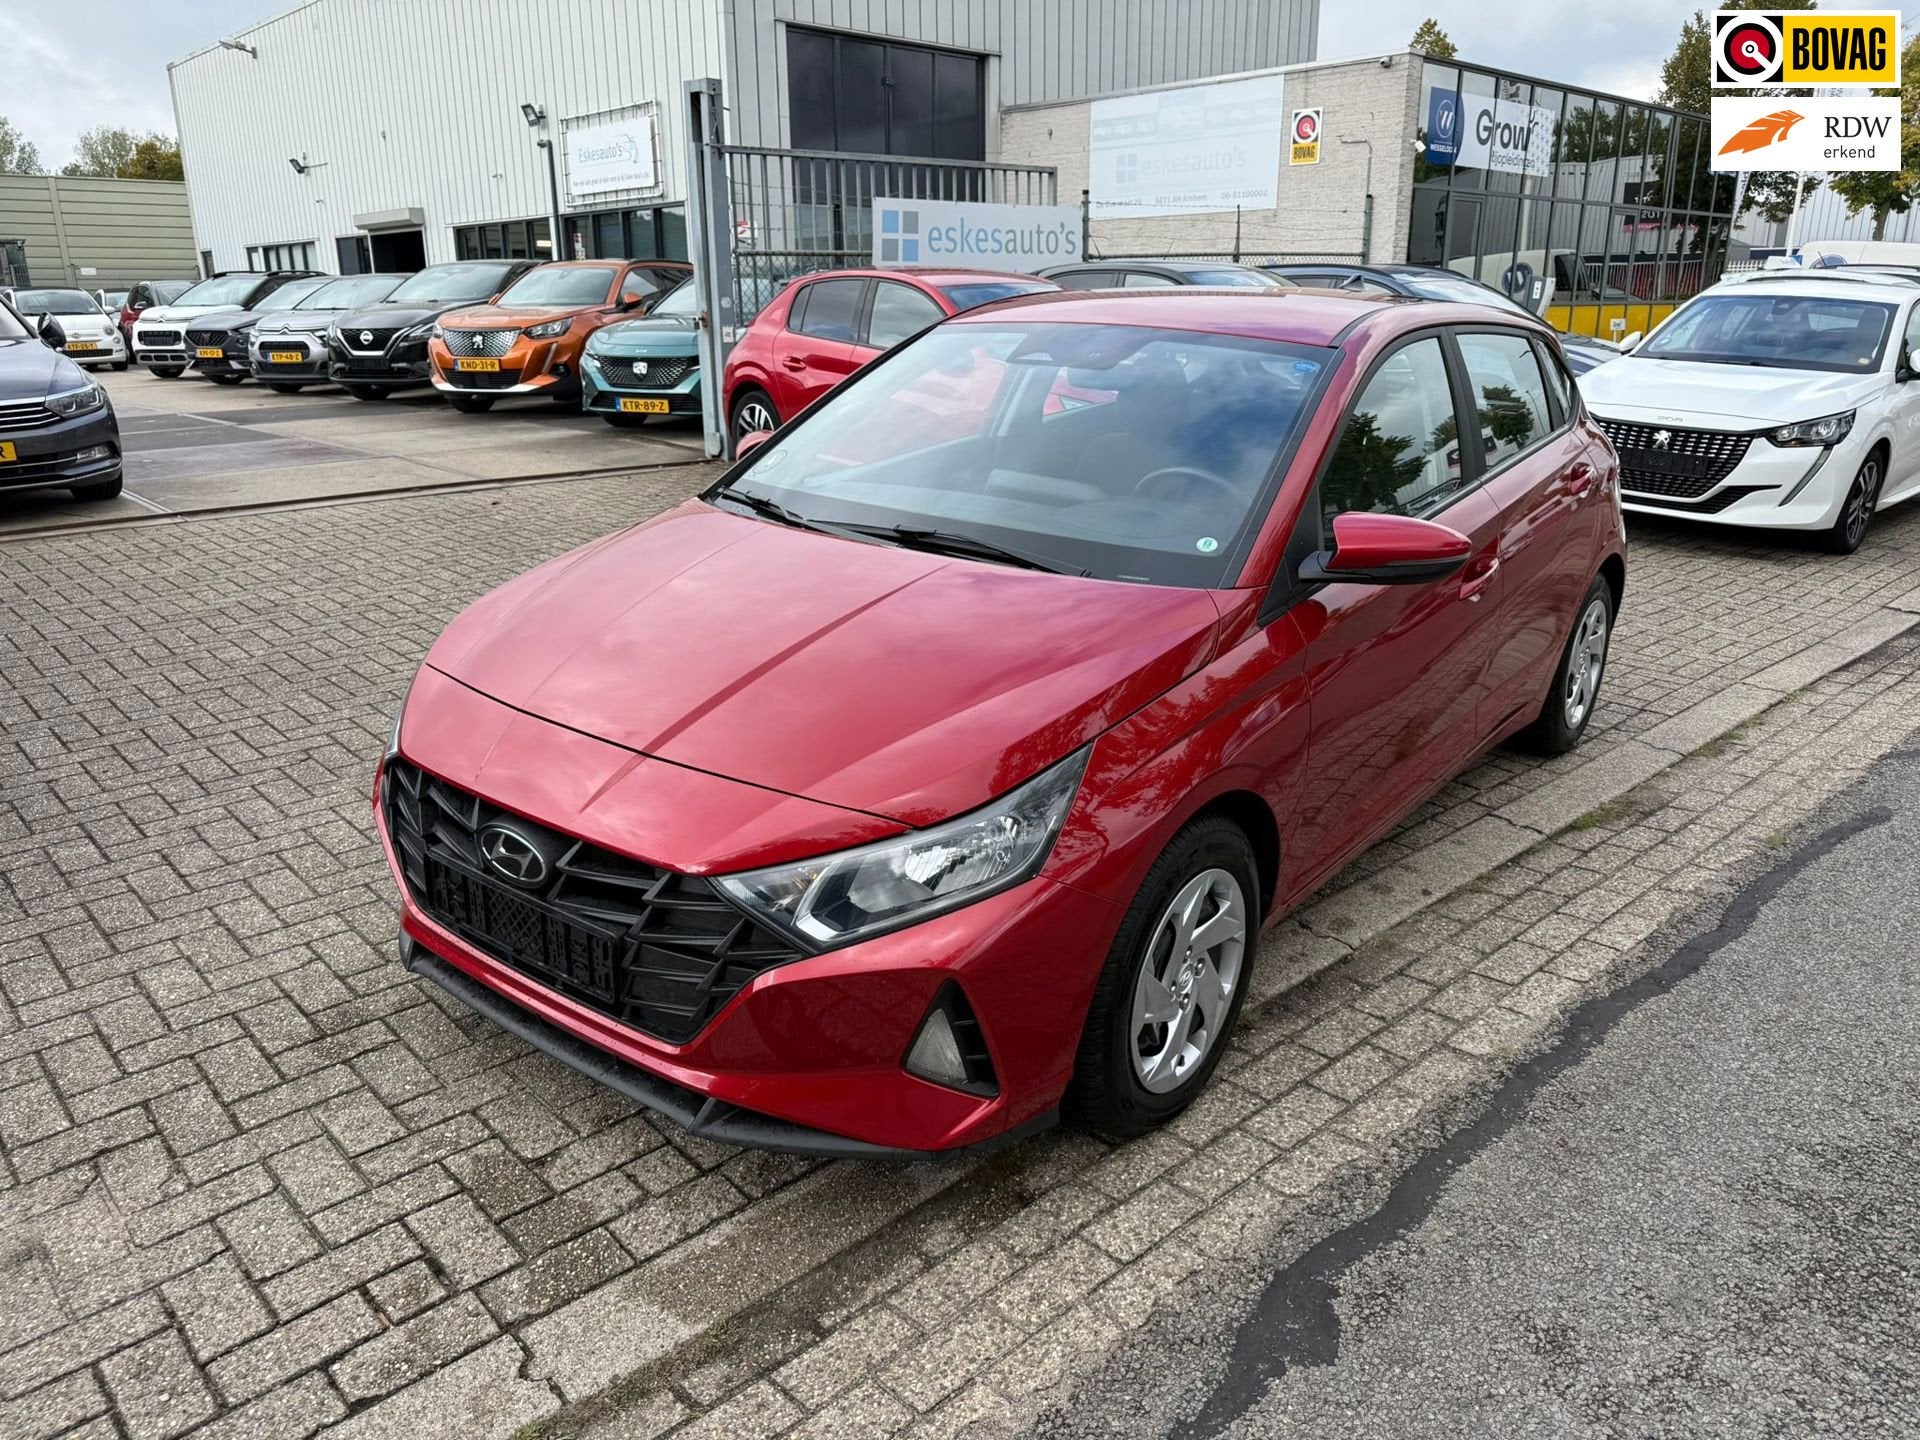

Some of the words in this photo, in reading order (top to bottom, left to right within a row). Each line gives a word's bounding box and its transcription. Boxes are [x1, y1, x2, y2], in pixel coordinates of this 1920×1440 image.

[1293, 145, 1316, 160] BOVAG
[1142, 147, 1247, 177] eskesauto's
[928, 217, 1076, 254] eskesauto's
[460, 360, 497, 370] KND-31-R
[622, 400, 665, 411] KTR-89-Z
